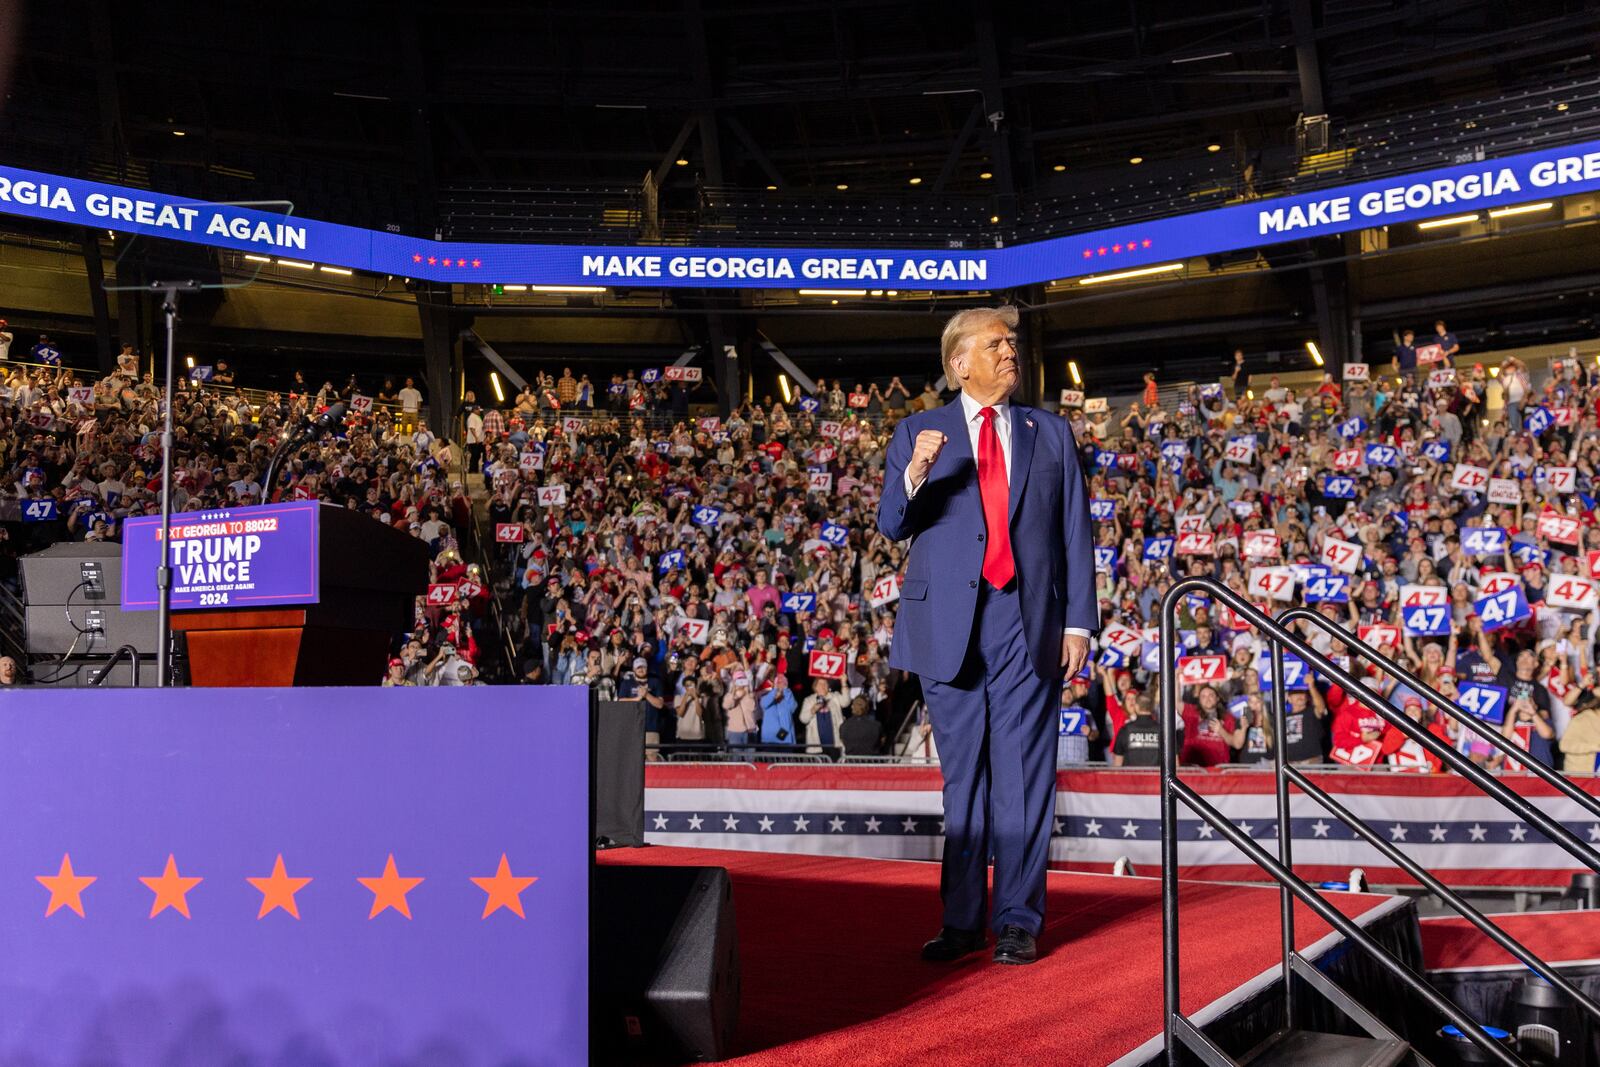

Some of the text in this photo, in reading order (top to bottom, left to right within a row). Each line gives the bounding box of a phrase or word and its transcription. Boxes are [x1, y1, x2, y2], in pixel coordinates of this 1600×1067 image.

[1456, 153, 1472, 164] 205
[1260, 197, 1350, 234] MAKE
[1359, 168, 1520, 216] GEORGIA
[86, 193, 199, 232] GREAT
[206, 214, 306, 250] AGAIN
[386, 224, 400, 232] 203
[582, 256, 987, 280] MAKE GEORGIA GREAT AGAIN
[38, 348, 58, 360] 47
[1420, 350, 1437, 359] 47
[192, 368, 209, 379] 47
[644, 370, 658, 380] 47
[666, 370, 681, 378] 47
[686, 370, 699, 379] 47
[1348, 366, 1364, 376] 47
[72, 389, 91, 401] 47
[1064, 394, 1079, 402] 47
[1202, 386, 1220, 396] 47
[354, 398, 370, 408] 47
[802, 402, 817, 410] 47
[851, 395, 866, 404] 47
[30, 416, 51, 427] 47
[567, 421, 580, 430] 47
[702, 420, 717, 429] 47
[1342, 418, 1360, 436] 47
[1529, 413, 1547, 429] 47
[824, 425, 839, 434] 47
[713, 433, 727, 441] 47
[1097, 453, 1114, 466] 47
[1228, 447, 1248, 458] 47
[1336, 452, 1358, 466] 47
[1369, 448, 1395, 462] 47
[524, 456, 540, 466] 47
[815, 476, 828, 486] 47
[1458, 472, 1485, 485] 47
[1548, 472, 1569, 486] 47
[1328, 480, 1352, 494] 47
[542, 490, 560, 501] 47
[26, 502, 52, 517] 47
[1091, 502, 1112, 515] 47
[696, 510, 718, 522] 47
[158, 519, 276, 538] TXT GEORGIA TO 88022
[499, 527, 520, 538] 47
[1180, 519, 1201, 532] 47
[1542, 519, 1572, 537] 47
[823, 526, 845, 540] 47
[1147, 540, 1172, 556] 47
[1182, 535, 1211, 549] 47
[1248, 537, 1276, 551] 47
[1465, 532, 1501, 551] 47
[170, 535, 260, 564] TRUMP
[1326, 545, 1353, 564] 47
[662, 553, 681, 568] 47
[180, 562, 250, 584] VANCE
[460, 582, 480, 596] 47
[874, 581, 891, 599] 47
[1259, 574, 1288, 593] 47
[1309, 578, 1343, 596] 47
[1484, 579, 1514, 594] 47
[430, 586, 454, 602] 47
[1555, 582, 1590, 601] 47
[200, 593, 228, 605] 2024
[785, 596, 812, 610] 47
[1406, 592, 1440, 606] 47
[1483, 592, 1517, 621] 47
[1408, 608, 1445, 630] 47
[679, 623, 704, 638] 47
[1108, 630, 1137, 645] 47
[814, 654, 842, 674] 47
[1184, 659, 1219, 678] 47
[1459, 688, 1500, 715] 47
[1130, 733, 1158, 742] POLICE
